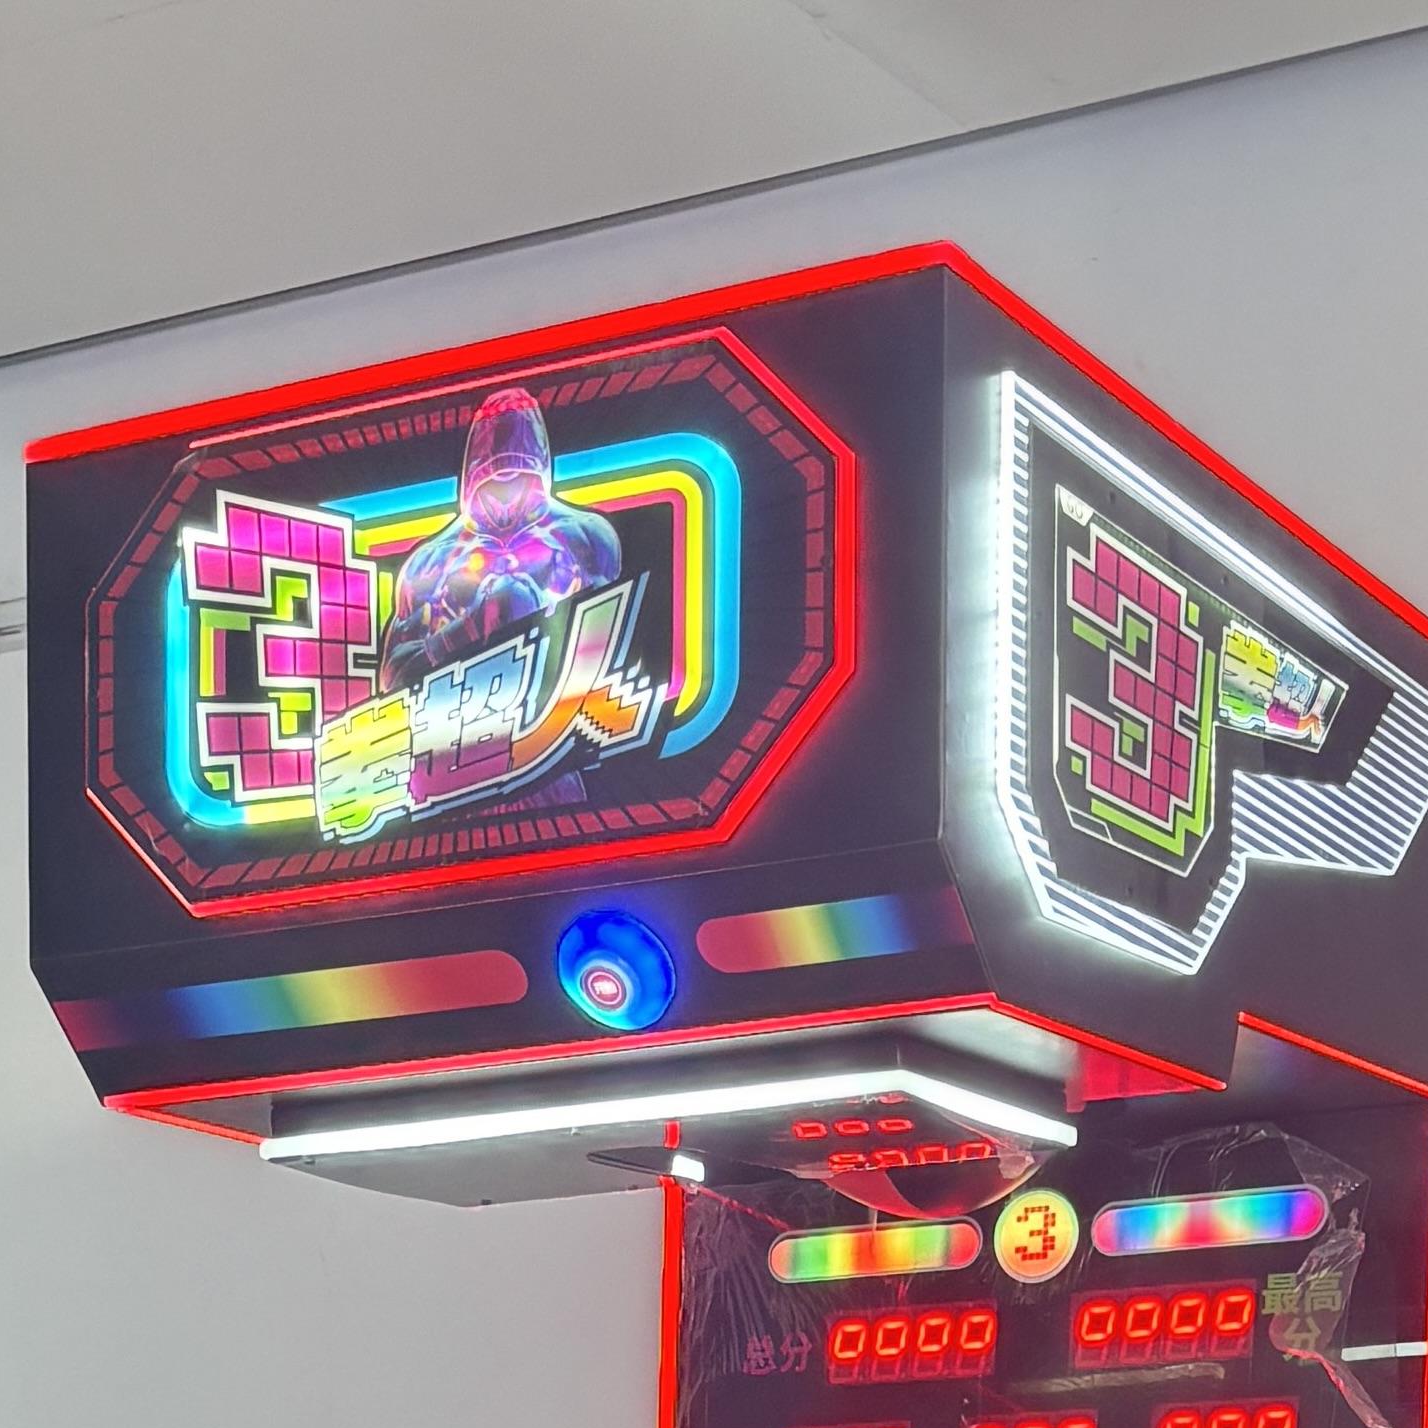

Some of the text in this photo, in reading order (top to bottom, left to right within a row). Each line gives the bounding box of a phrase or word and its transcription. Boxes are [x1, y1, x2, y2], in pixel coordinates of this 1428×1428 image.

[1015, 1205, 1056, 1261] 3
[1078, 1292, 1254, 1344] 0000
[1262, 1271, 1344, 1315] 最高
[743, 1331, 813, 1376] 总分
[832, 1312, 996, 1362] 0000
